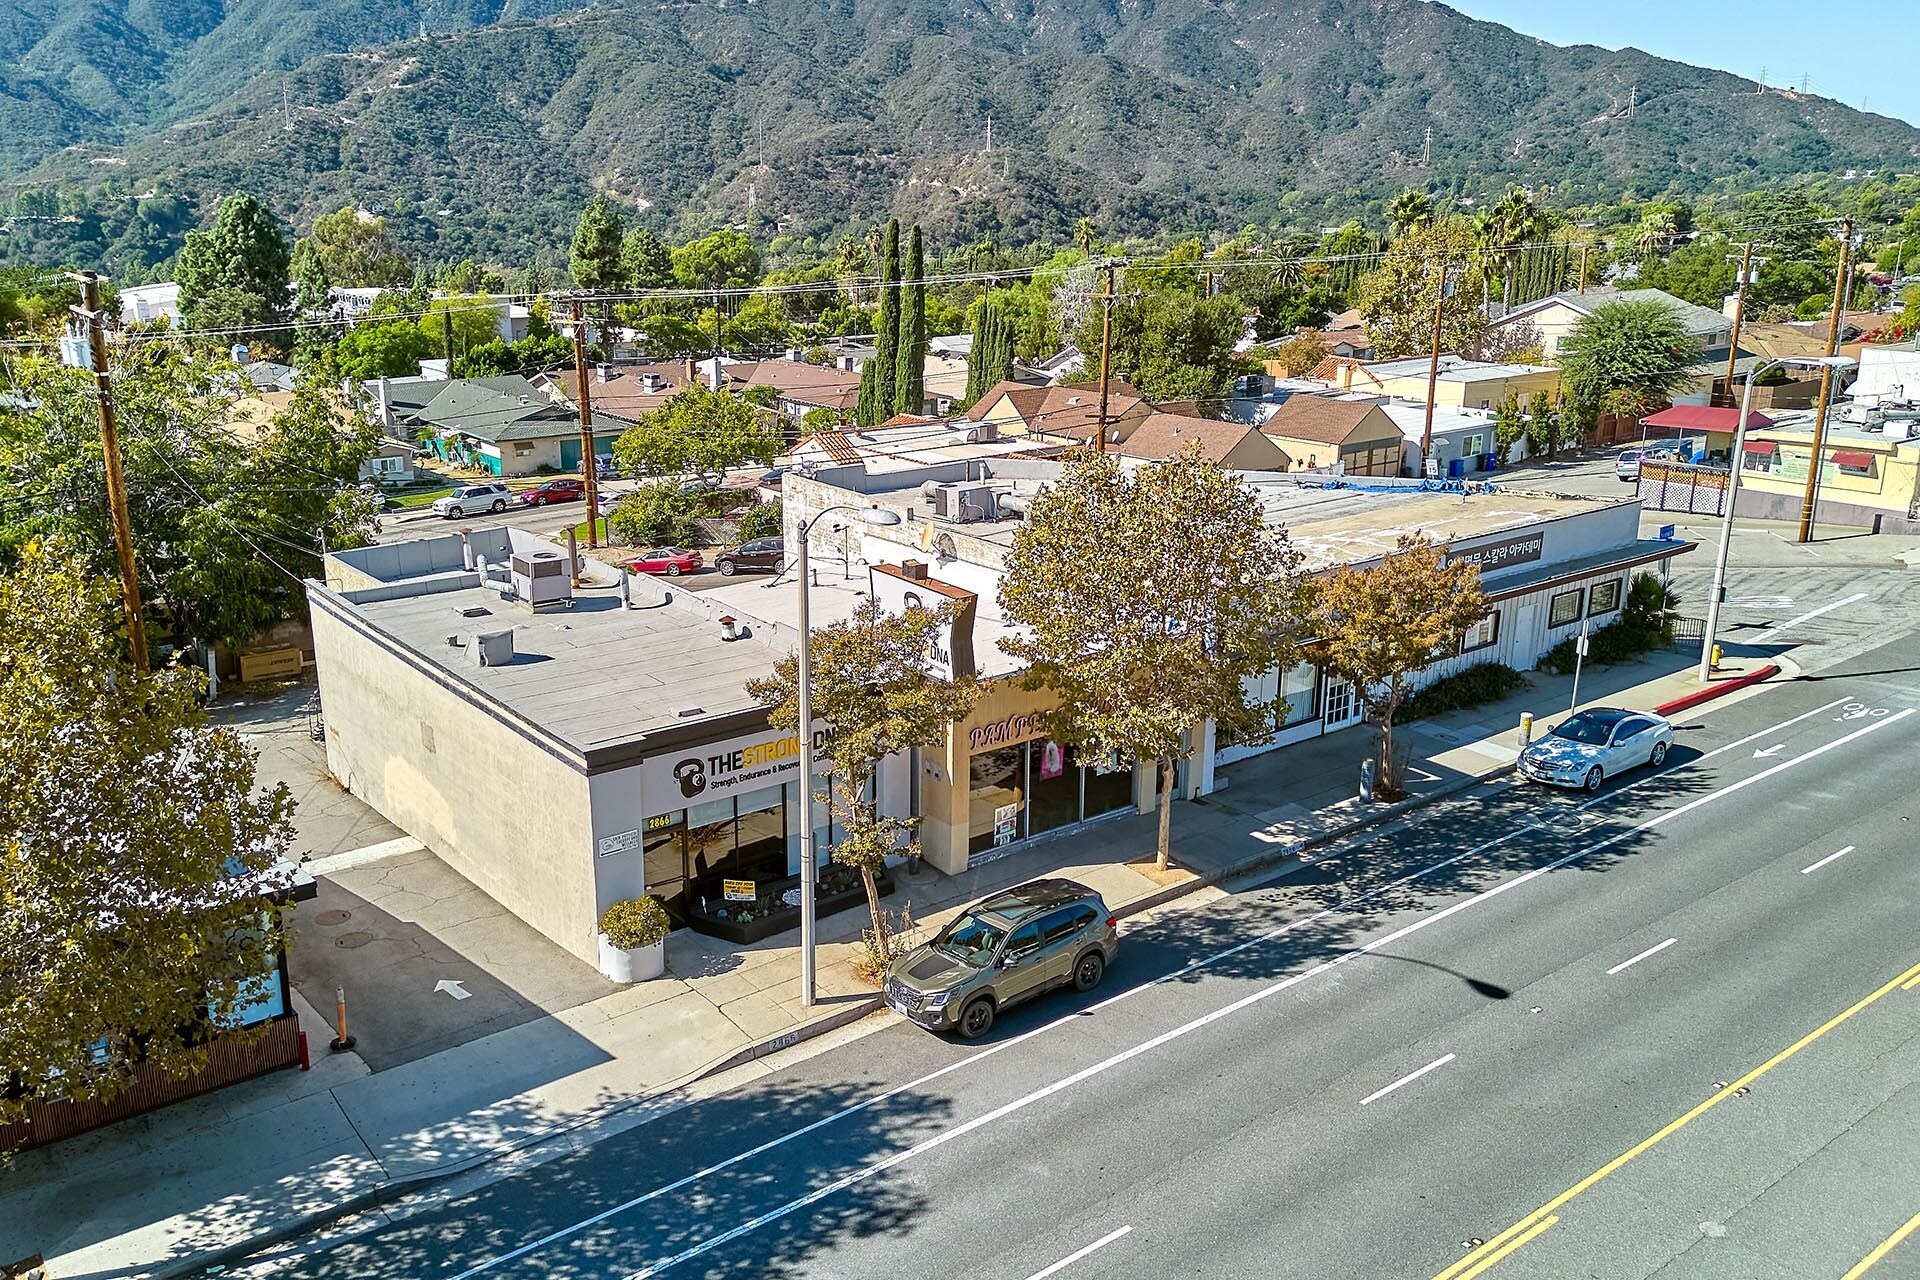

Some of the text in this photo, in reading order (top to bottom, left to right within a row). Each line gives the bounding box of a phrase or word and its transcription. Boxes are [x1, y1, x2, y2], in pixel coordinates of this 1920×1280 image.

[1483, 546, 1508, 563] 스칼라
[1509, 538, 1541, 556] 아카데미
[930, 644, 949, 666] DNA
[742, 736, 801, 768] STRON
[813, 726, 836, 750] DN
[739, 768, 771, 782] Endurance
[649, 815, 670, 829] 2866
